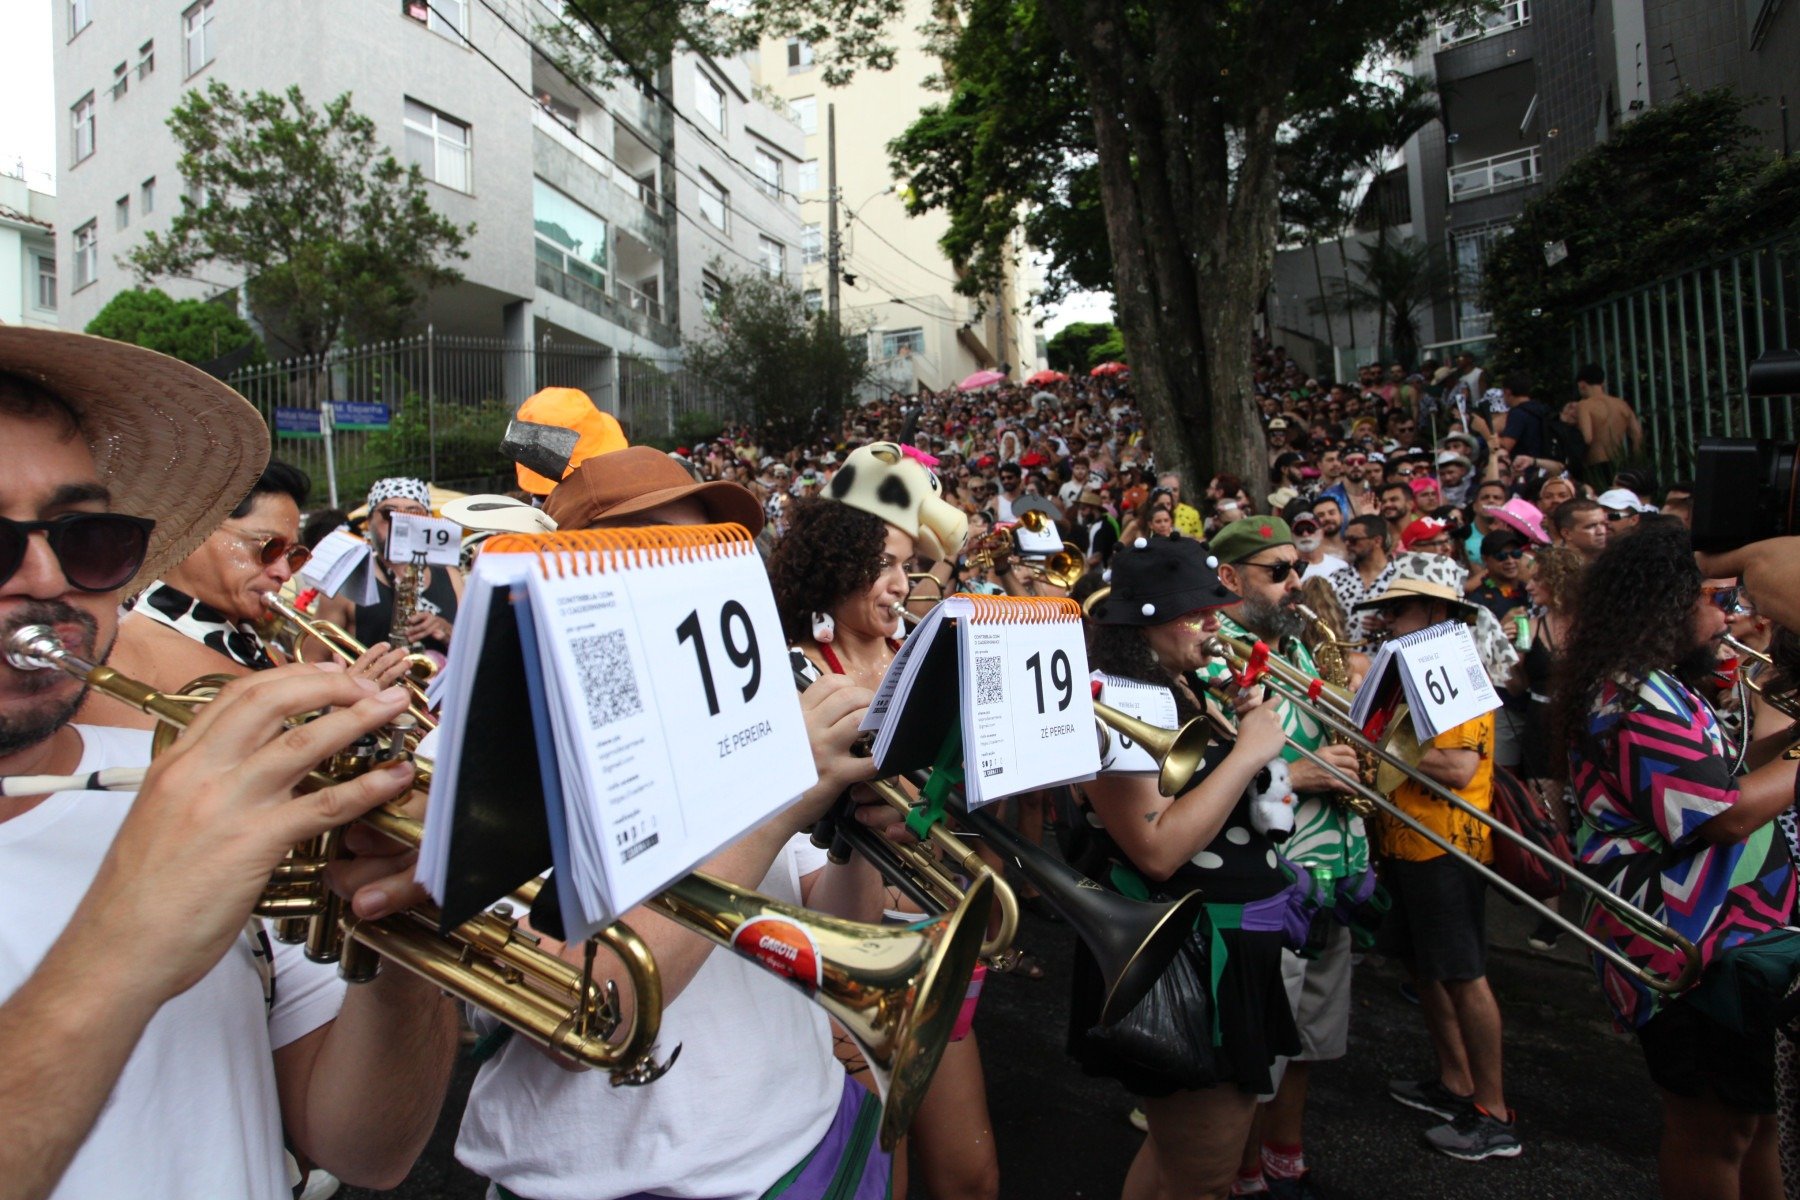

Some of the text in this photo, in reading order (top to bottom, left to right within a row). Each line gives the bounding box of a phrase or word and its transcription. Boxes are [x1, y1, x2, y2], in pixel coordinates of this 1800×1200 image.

[422, 528, 450, 546] 19
[675, 599, 762, 717] 19
[1026, 648, 1073, 714] 19
[1425, 665, 1459, 706] 19
[717, 719, 773, 759] ZÉ PEREIRA
[1040, 724, 1075, 739] ZÉ PEREIRA
[759, 936, 798, 961] GAROTA
